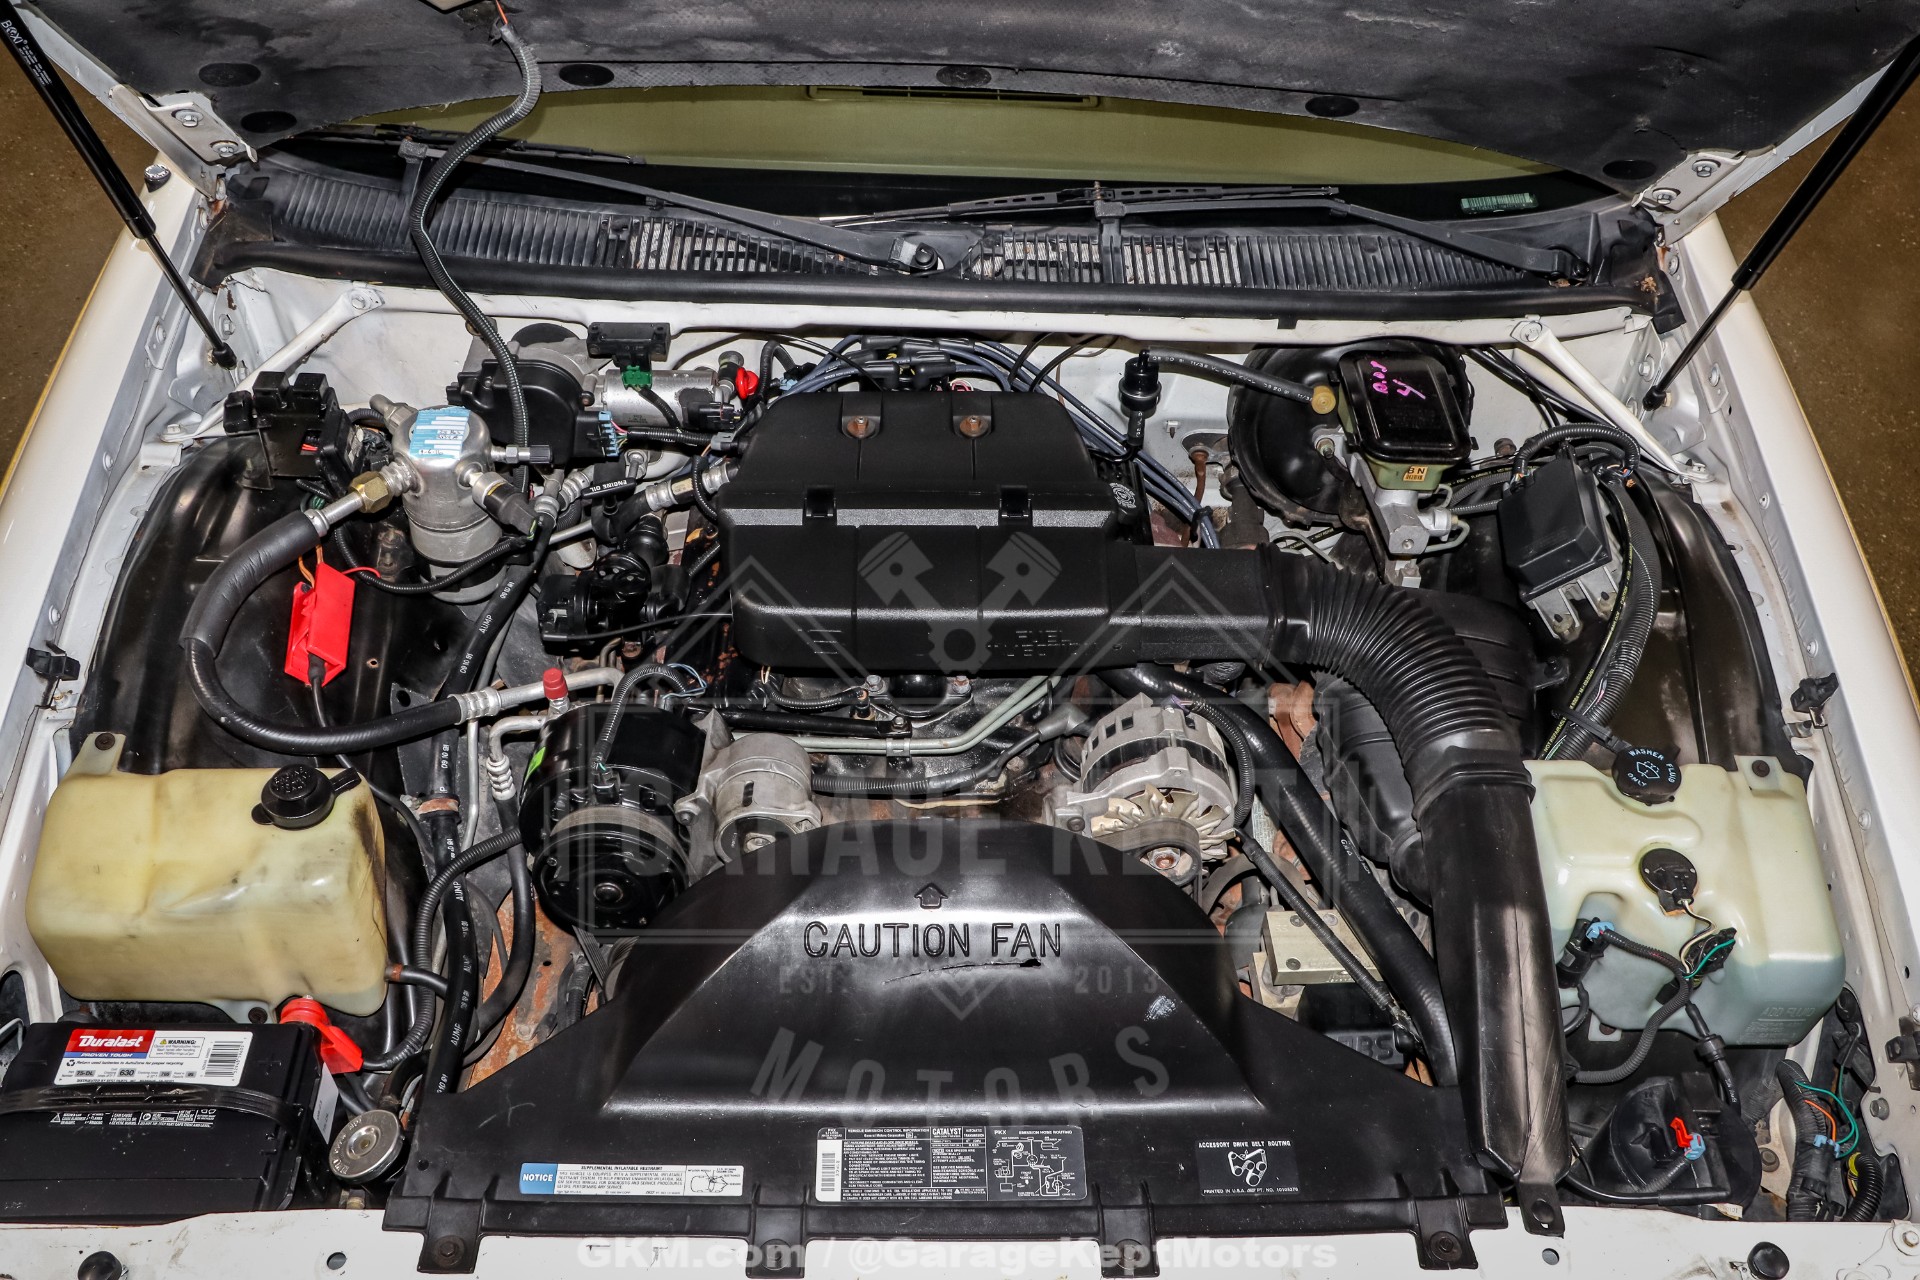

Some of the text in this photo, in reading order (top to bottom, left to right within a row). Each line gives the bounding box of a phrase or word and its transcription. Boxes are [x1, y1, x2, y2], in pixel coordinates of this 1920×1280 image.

[602, 480, 628, 490] ENGINE
[479, 614, 493, 634] AUMP
[1628, 748, 1678, 786] WASHER FLUID ONLY
[803, 920, 1061, 957] CAUTION FAN
[78, 1036, 144, 1047] Duralast
[522, 1174, 553, 1182] NOTICE
